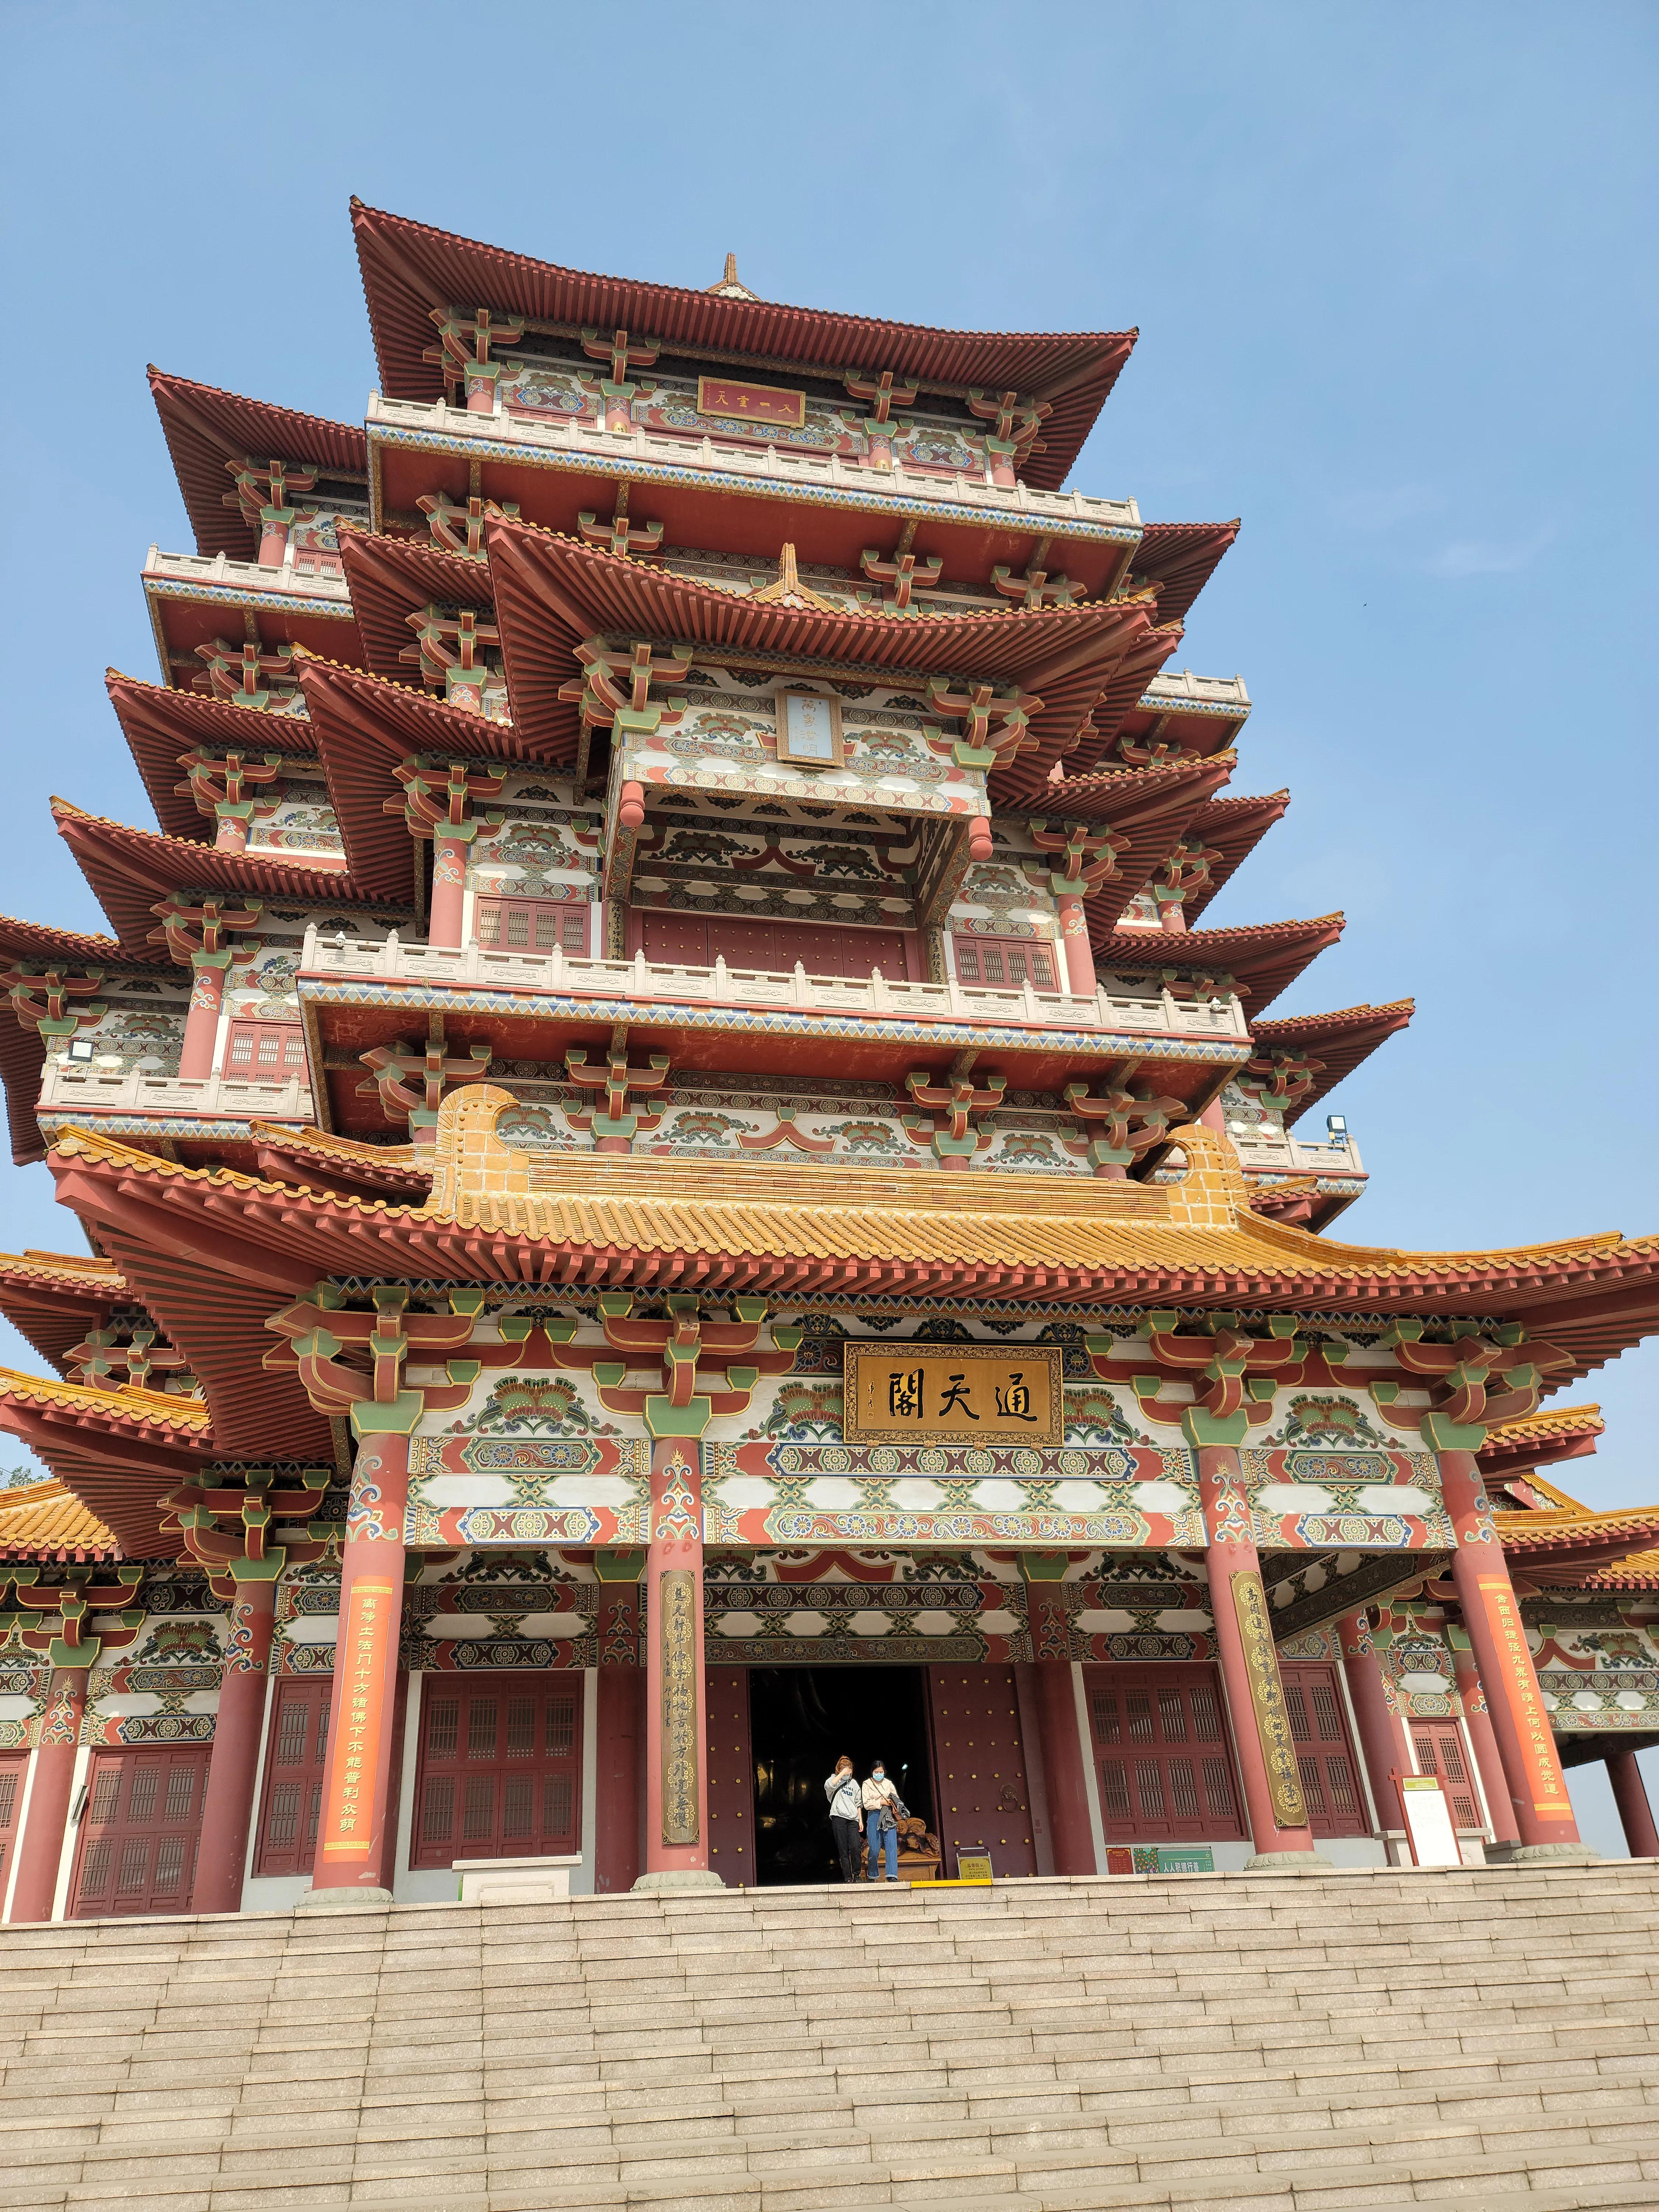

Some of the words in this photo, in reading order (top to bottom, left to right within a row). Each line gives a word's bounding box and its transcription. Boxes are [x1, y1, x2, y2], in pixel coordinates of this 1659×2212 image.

[715, 391, 794, 413] 又一重天
[888, 1367, 1039, 1422] 通天閣
[339, 1598, 378, 1832] 离净土法门十方诸佛下不能普利众萌
[1495, 1594, 1559, 1795] 舍西归捷径九界有情上何以圆成觉道
